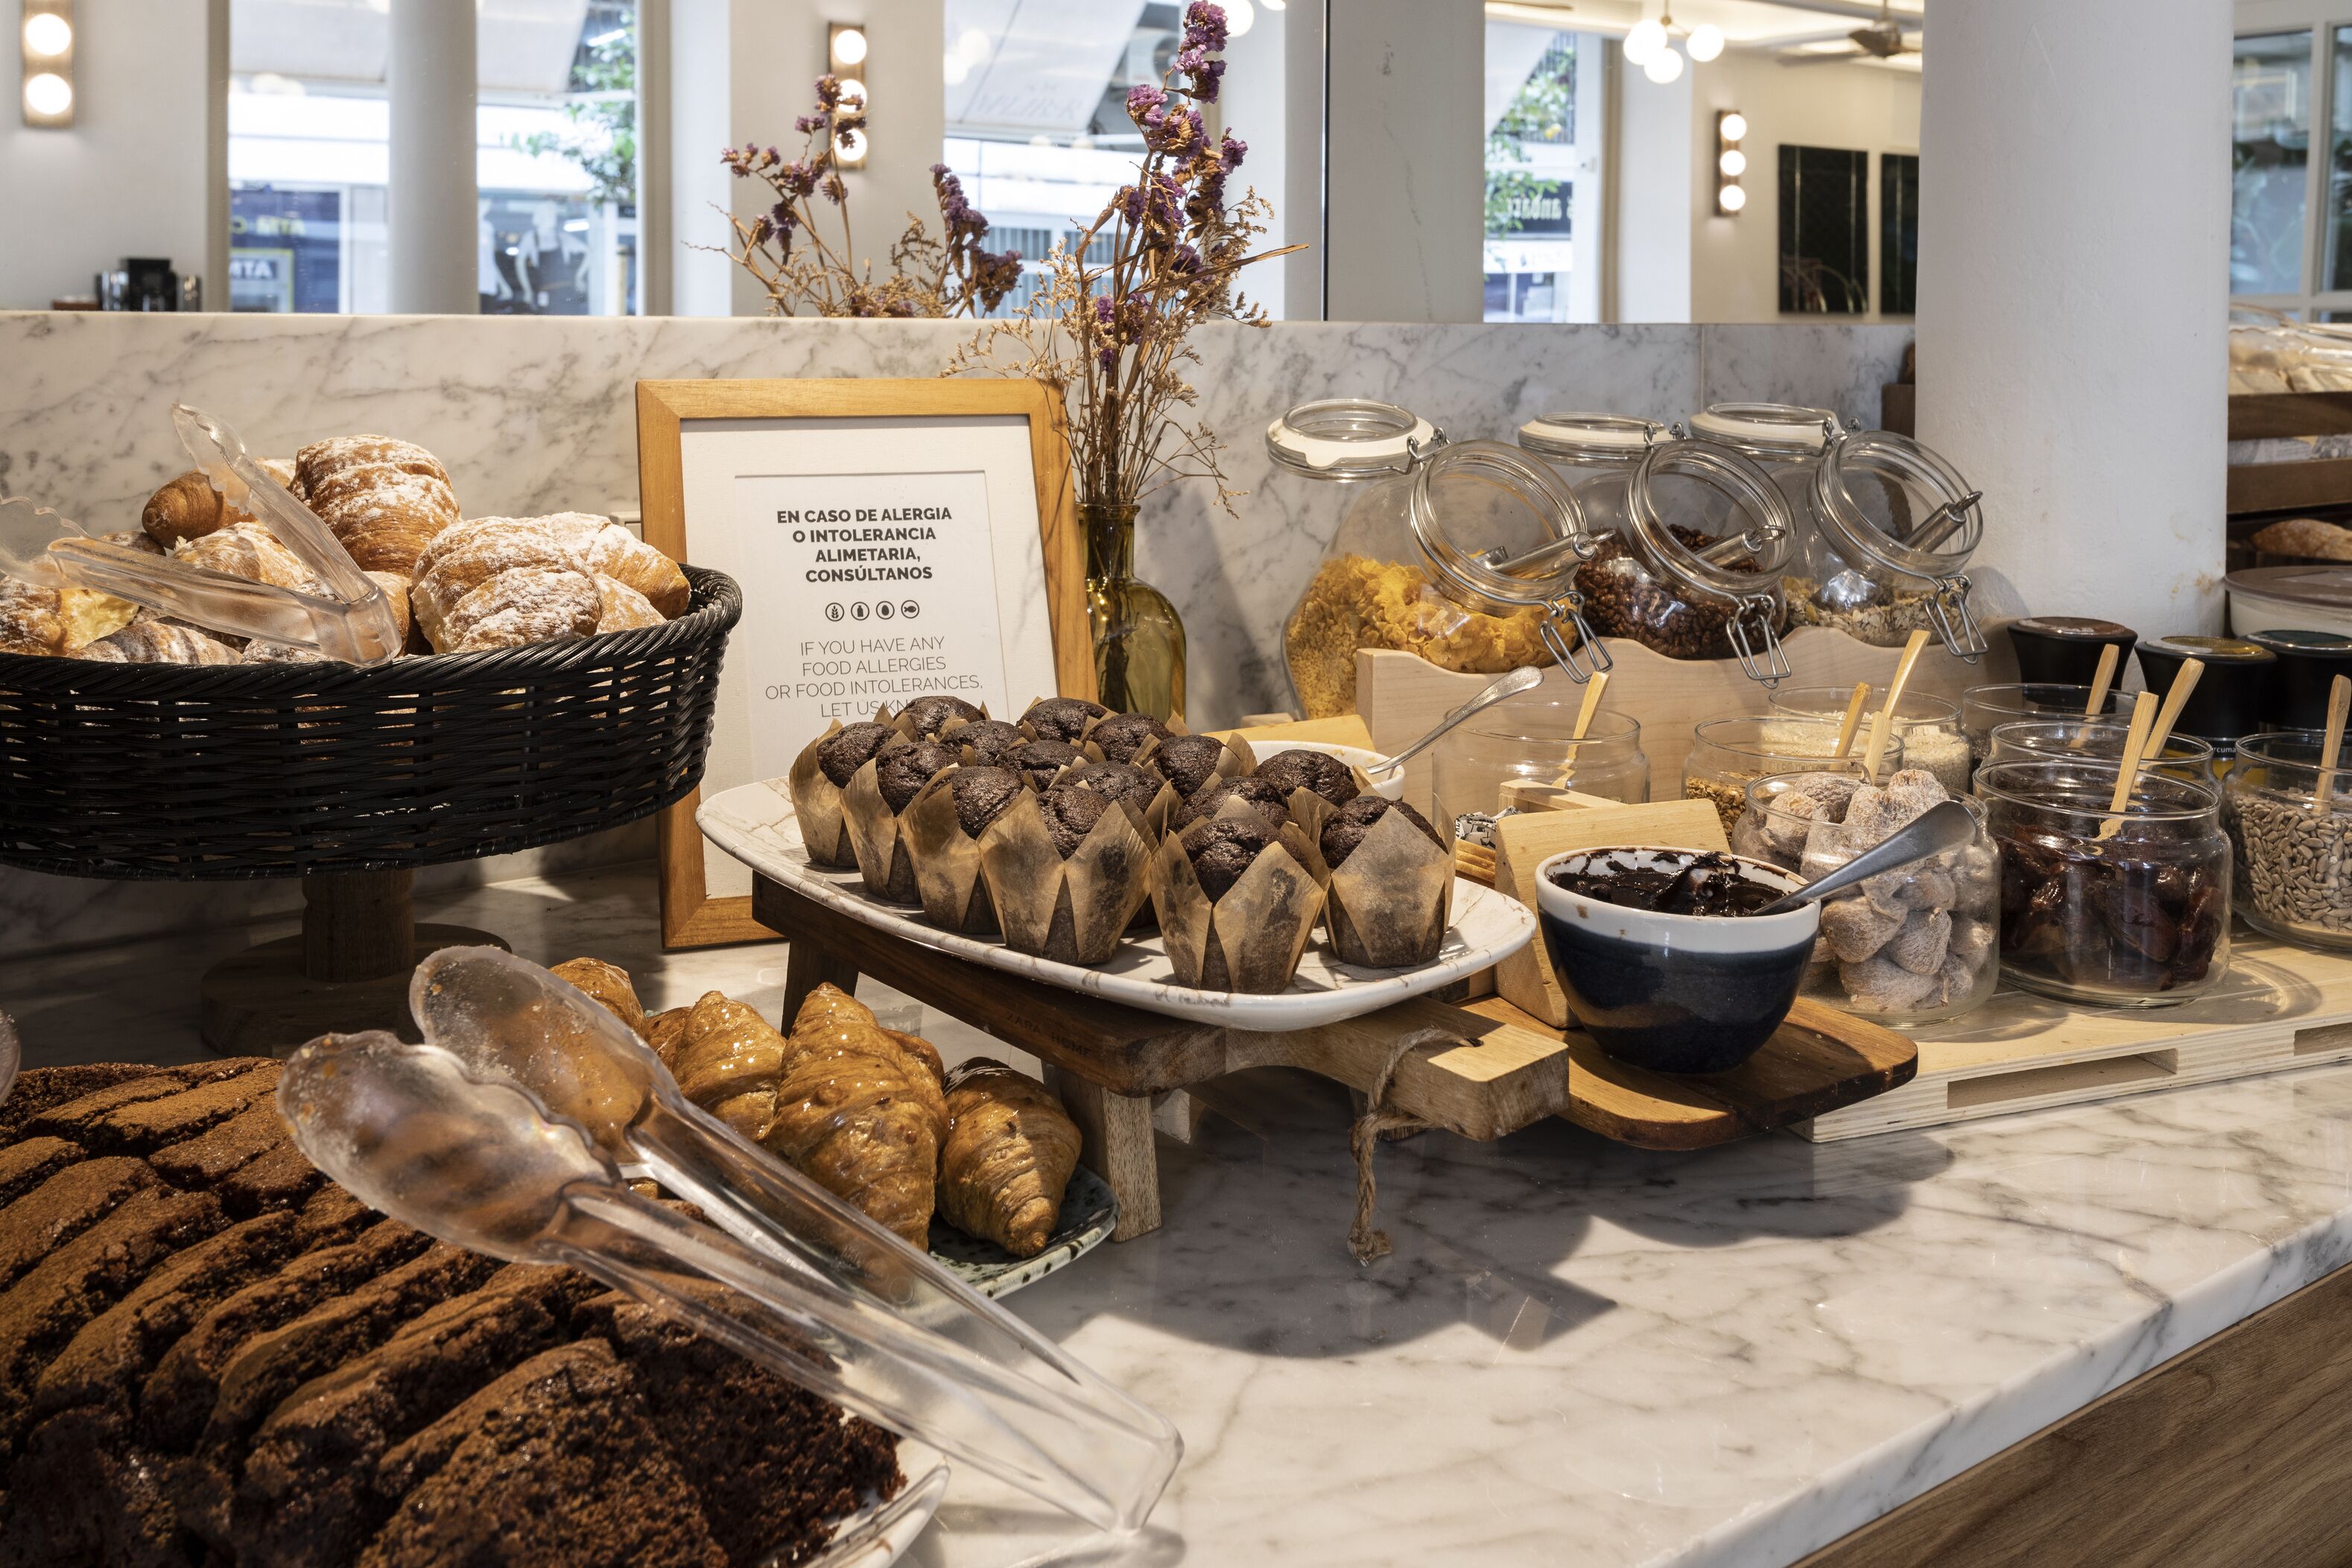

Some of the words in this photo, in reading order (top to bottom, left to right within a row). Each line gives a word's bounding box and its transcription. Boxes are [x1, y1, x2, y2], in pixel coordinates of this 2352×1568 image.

[777, 510, 799, 523] EN
[804, 510, 851, 523] CASO
[855, 509, 878, 521] DE
[881, 507, 952, 521] ALERGIA
[793, 530, 805, 543] O
[810, 527, 936, 542] INTOLERANCIA
[815, 547, 921, 562] ALIMETARIA,
[805, 565, 933, 583] CONSÚLTANOS
[800, 641, 814, 656] IF
[819, 640, 855, 655] YOU
[860, 638, 905, 653] HAVE
[910, 636, 945, 650] ANY
[802, 661, 851, 676] FOOD
[856, 656, 947, 673] ALLERGIES
[765, 685, 790, 699] OR
[796, 682, 845, 698] FOOD
[851, 674, 983, 694] INTOLERANCES,
[820, 702, 852, 717] LET
[857, 700, 880, 715] US
[884, 699, 910, 714] KN
[1007, 1012, 1041, 1034] ZARA
